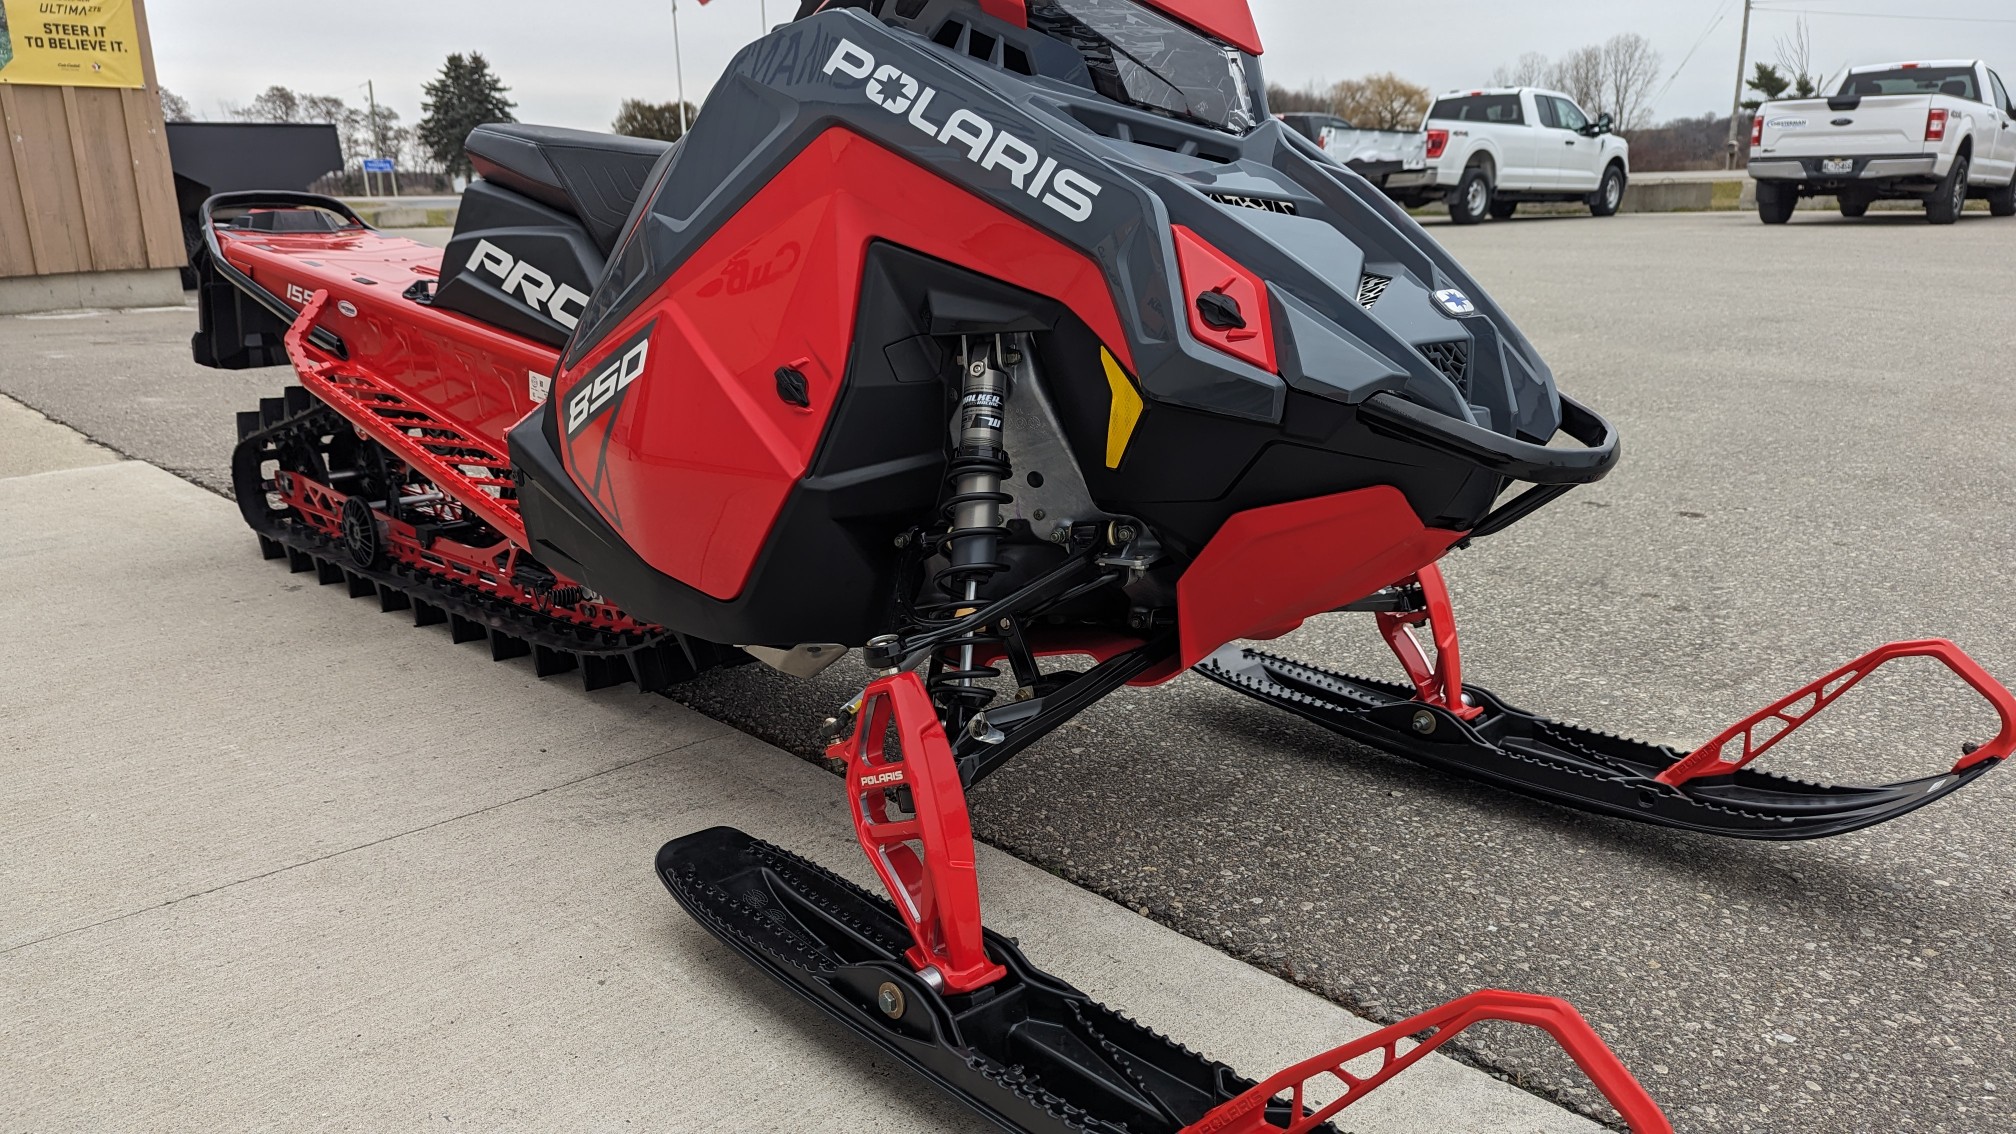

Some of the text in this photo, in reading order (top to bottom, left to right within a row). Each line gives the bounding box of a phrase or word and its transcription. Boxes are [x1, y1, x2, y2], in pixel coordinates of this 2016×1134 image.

[40, 3, 87, 16] ULTIMA
[43, 23, 106, 37] STEER IT
[25, 36, 127, 53] TO BELIEVE IT.
[822, 38, 1102, 222] POLARIS
[568, 338, 648, 434] 850
[861, 770, 904, 786] POLARIS
[1198, 1090, 1264, 1134] POLARIS
